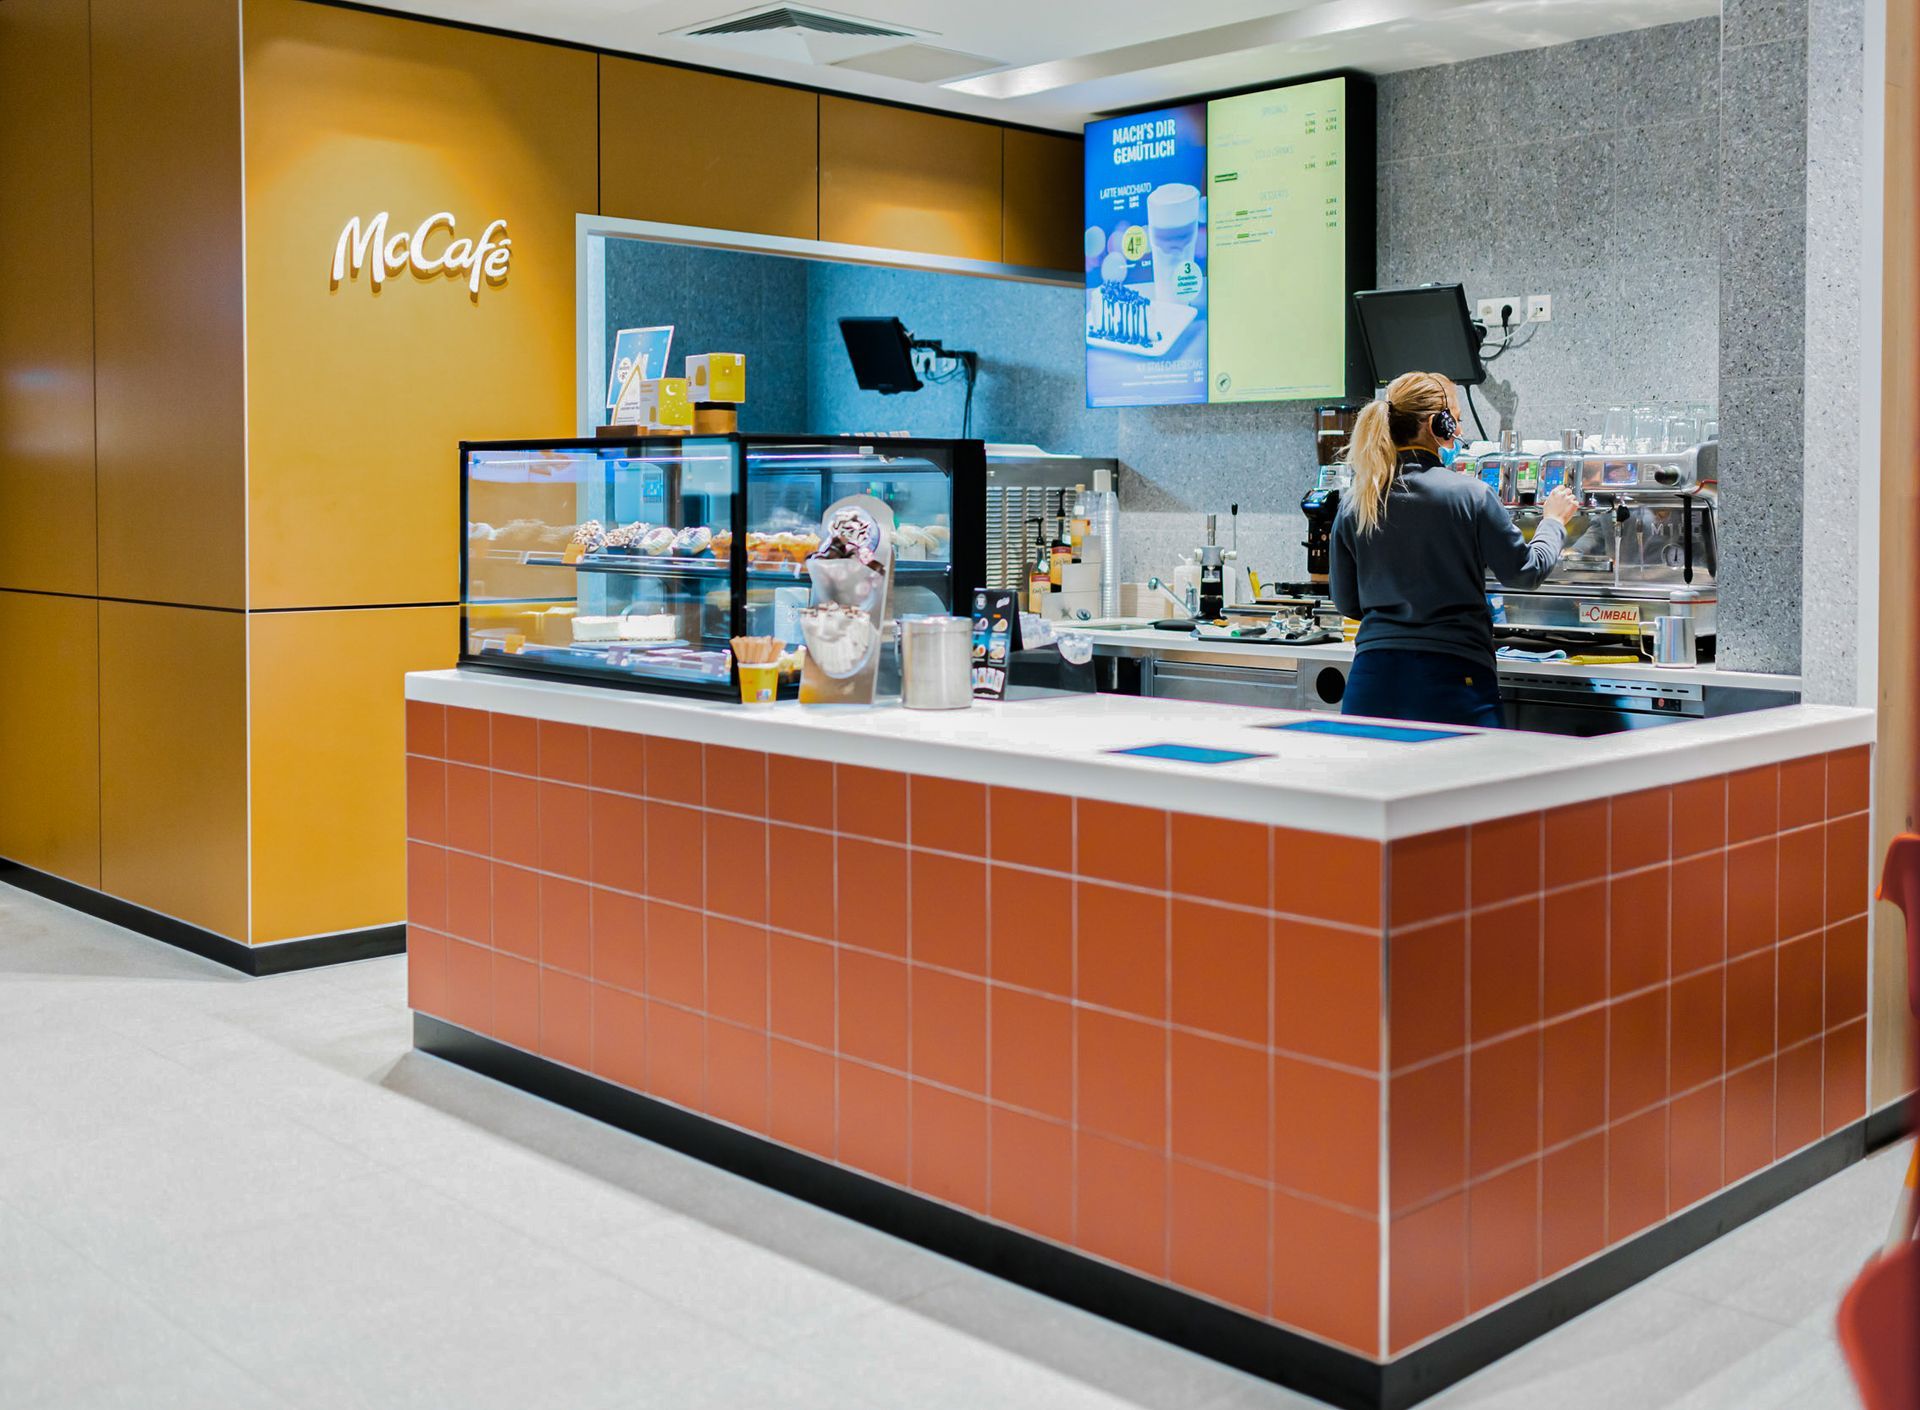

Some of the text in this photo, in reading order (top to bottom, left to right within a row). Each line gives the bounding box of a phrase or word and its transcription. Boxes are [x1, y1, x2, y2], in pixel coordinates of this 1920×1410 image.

[1112, 118, 1176, 146] MACH'S DIR
[1113, 138, 1176, 165] GEMÜTLICH
[1100, 187, 1117, 200] LATTE
[332, 211, 512, 293] McCafé
[1184, 262, 1192, 274] 3
[1589, 606, 1638, 622] CIMBALI
